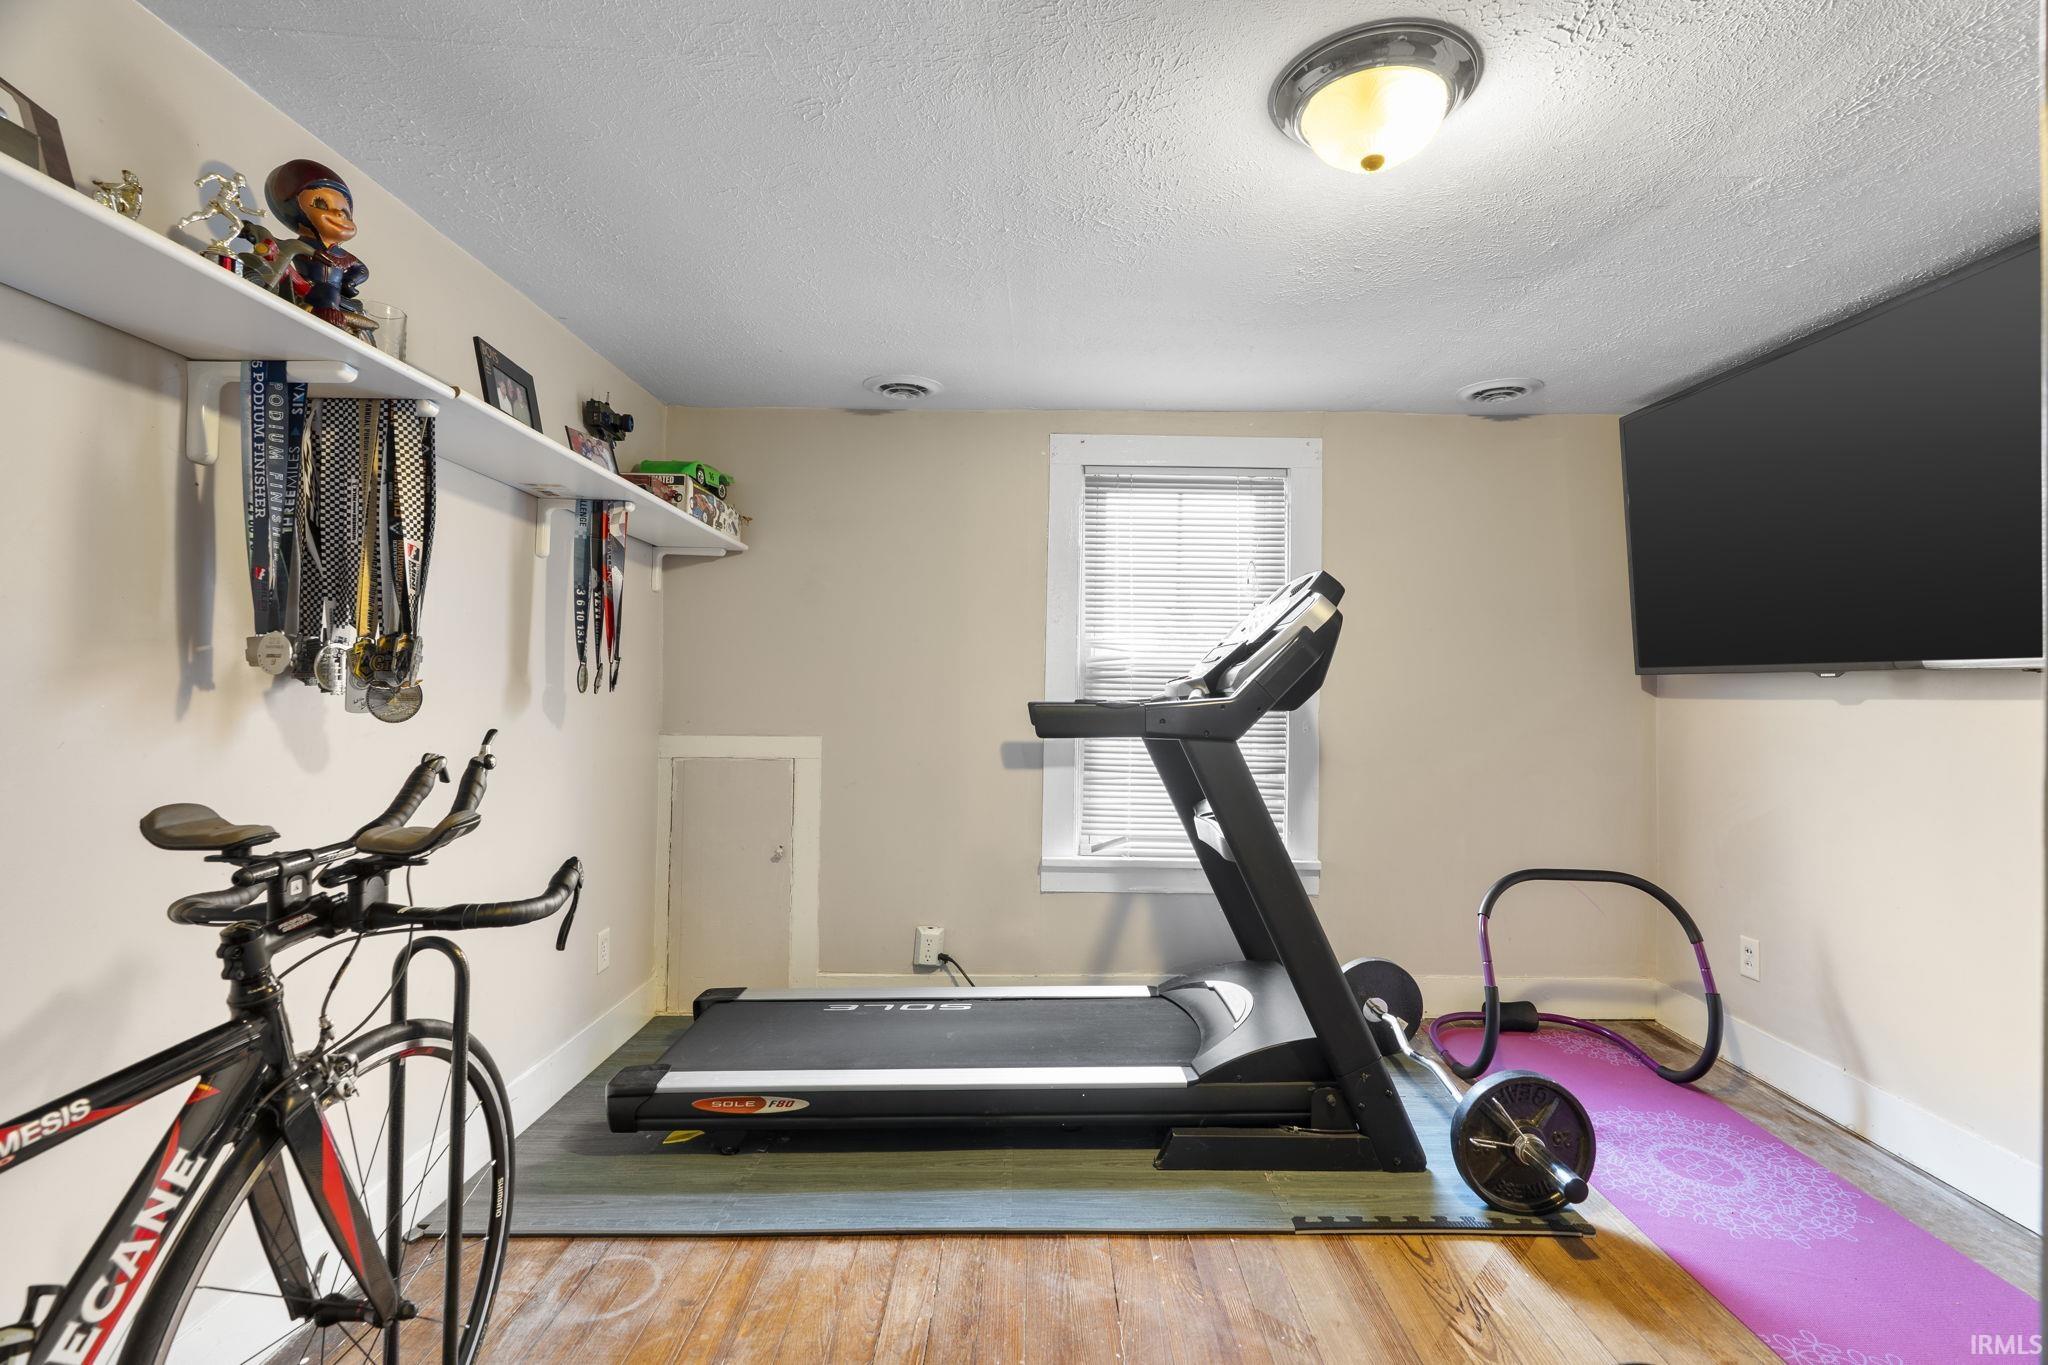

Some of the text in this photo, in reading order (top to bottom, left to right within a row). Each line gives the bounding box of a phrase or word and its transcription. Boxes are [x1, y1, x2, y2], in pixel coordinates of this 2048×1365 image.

[253, 372, 265, 438] PODIUM
[268, 382, 284, 460] PODIUM
[254, 442, 266, 518] FINISHER
[576, 588, 586, 596] 3
[576, 610, 585, 622] 10
[576, 624, 585, 643] 13.1
[823, 1003, 973, 1011] SOLE
[711, 1100, 796, 1108] SOLE F80
[0, 1098, 92, 1158] MESIS
[44, 1147, 207, 1365] ECANE
